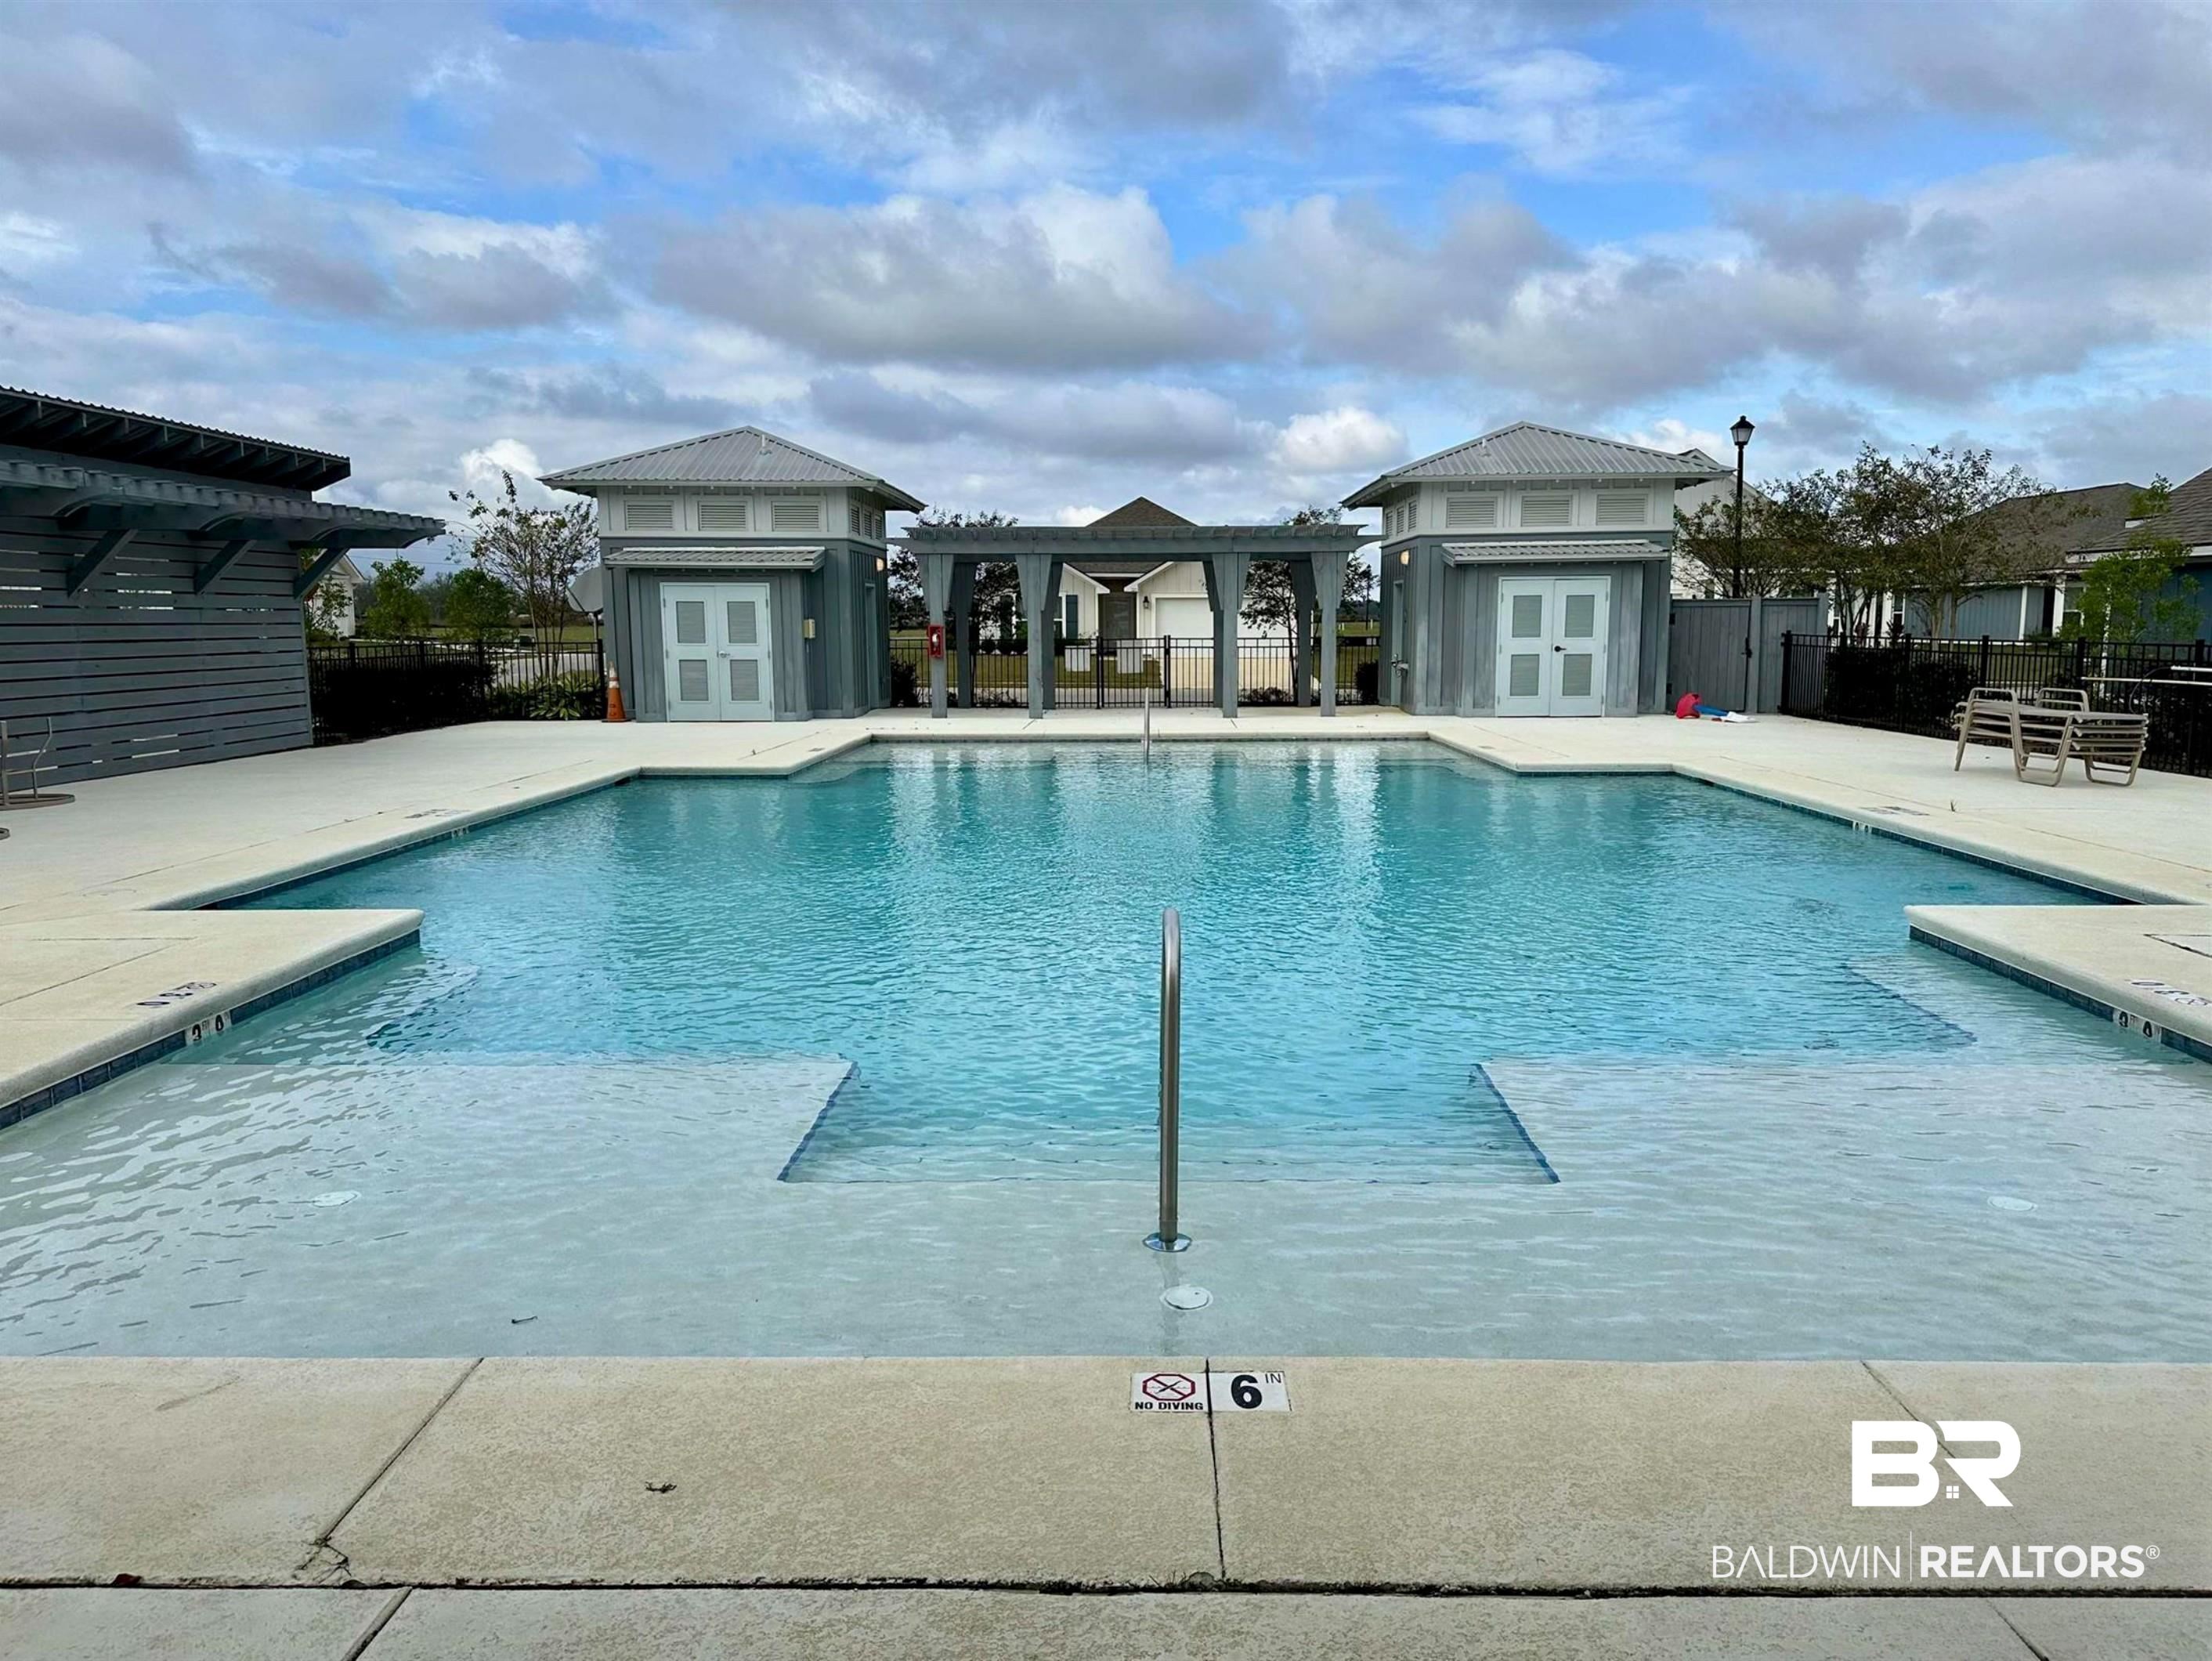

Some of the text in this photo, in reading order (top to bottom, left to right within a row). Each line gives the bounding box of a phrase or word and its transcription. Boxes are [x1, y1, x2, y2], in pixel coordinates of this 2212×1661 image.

[1231, 1373, 1282, 1409] 6 IN
[1135, 1402, 1204, 1410] NO DIVING
